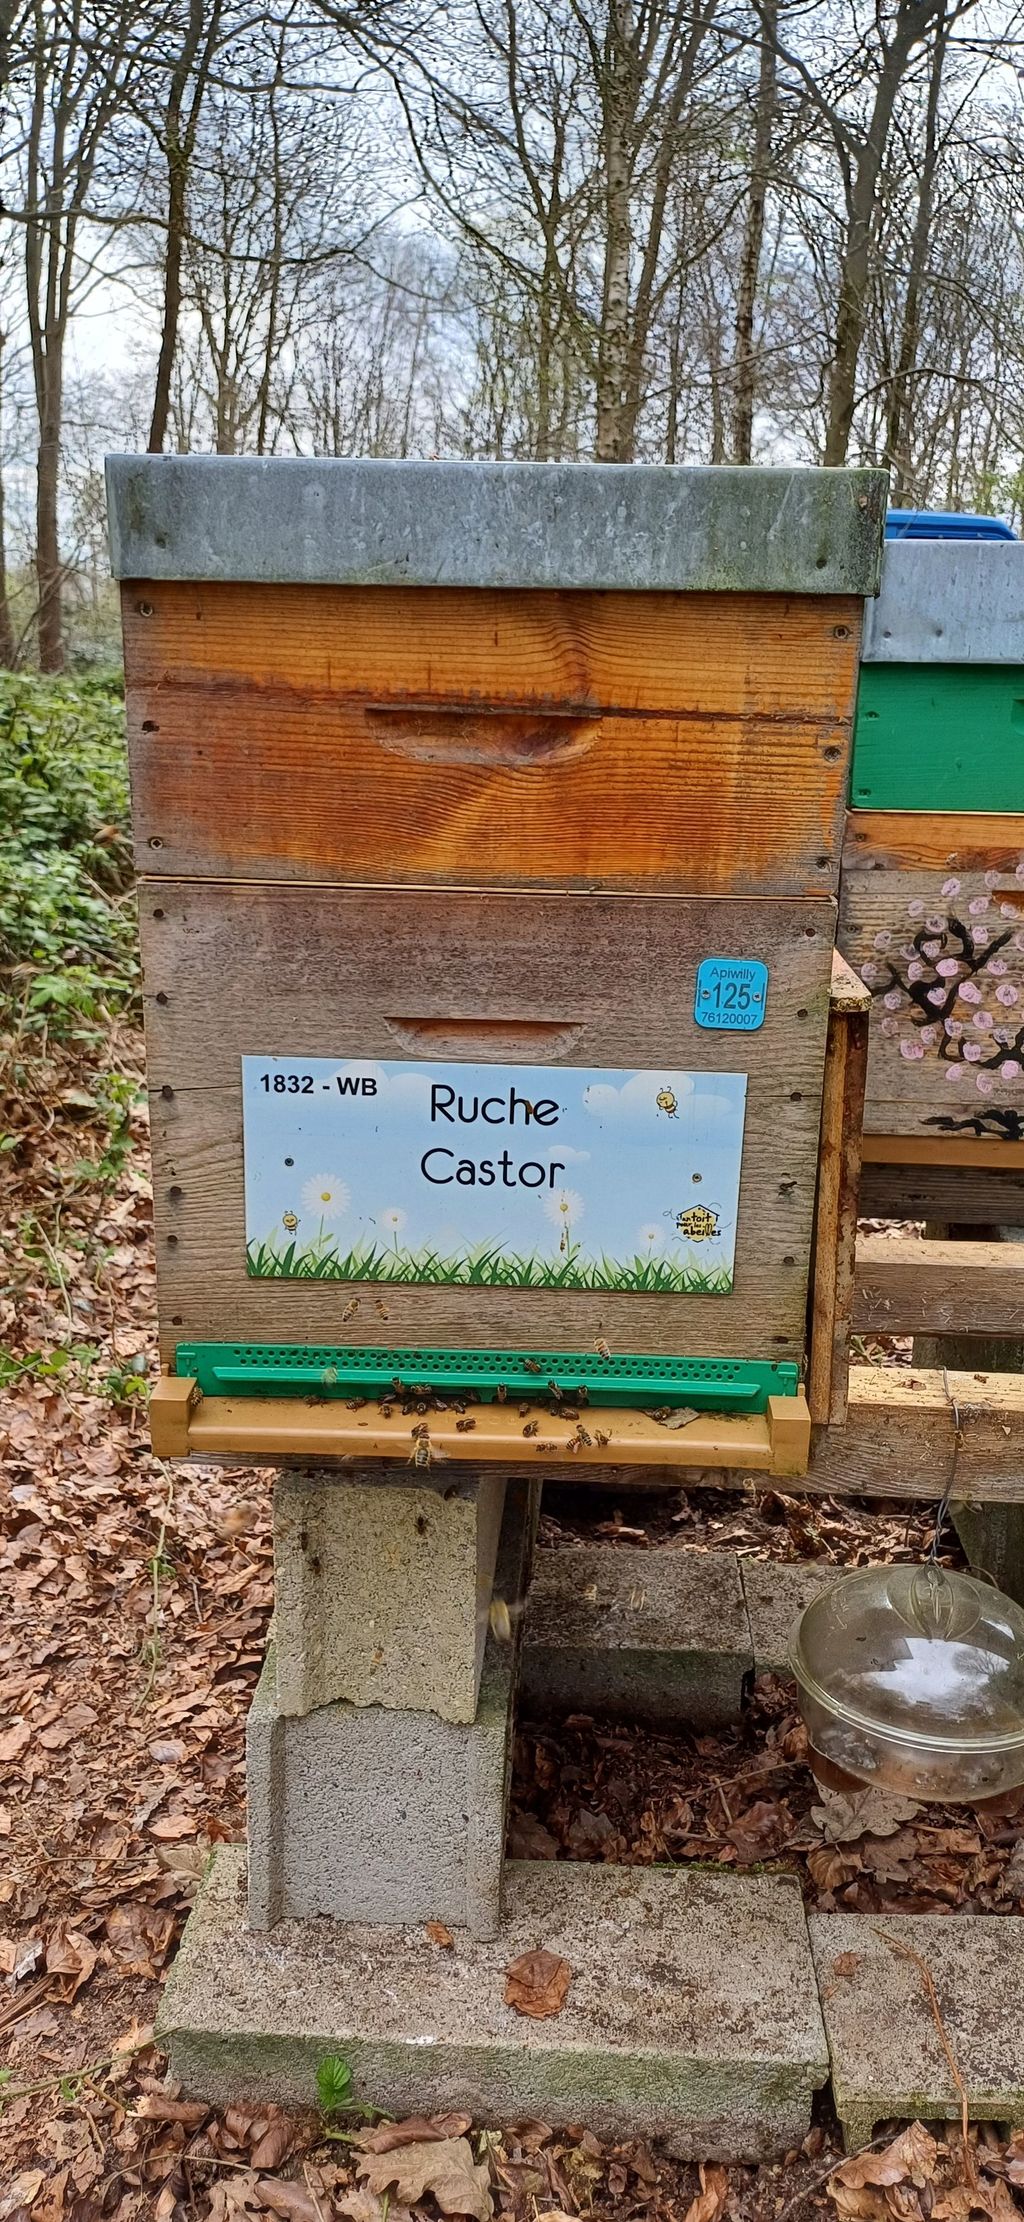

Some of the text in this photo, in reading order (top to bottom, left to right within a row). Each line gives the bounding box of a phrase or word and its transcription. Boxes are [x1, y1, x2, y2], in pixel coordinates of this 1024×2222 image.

[710, 967, 756, 982] Apiwilly
[713, 982, 750, 1009] 125
[701, 1012, 757, 1025] 76120007
[260, 1074, 314, 1094] 1832
[336, 1076, 378, 1096] WB
[431, 1084, 560, 1126] Ruche
[420, 1147, 566, 1189] Castor
[691, 1212, 711, 1222] toit
